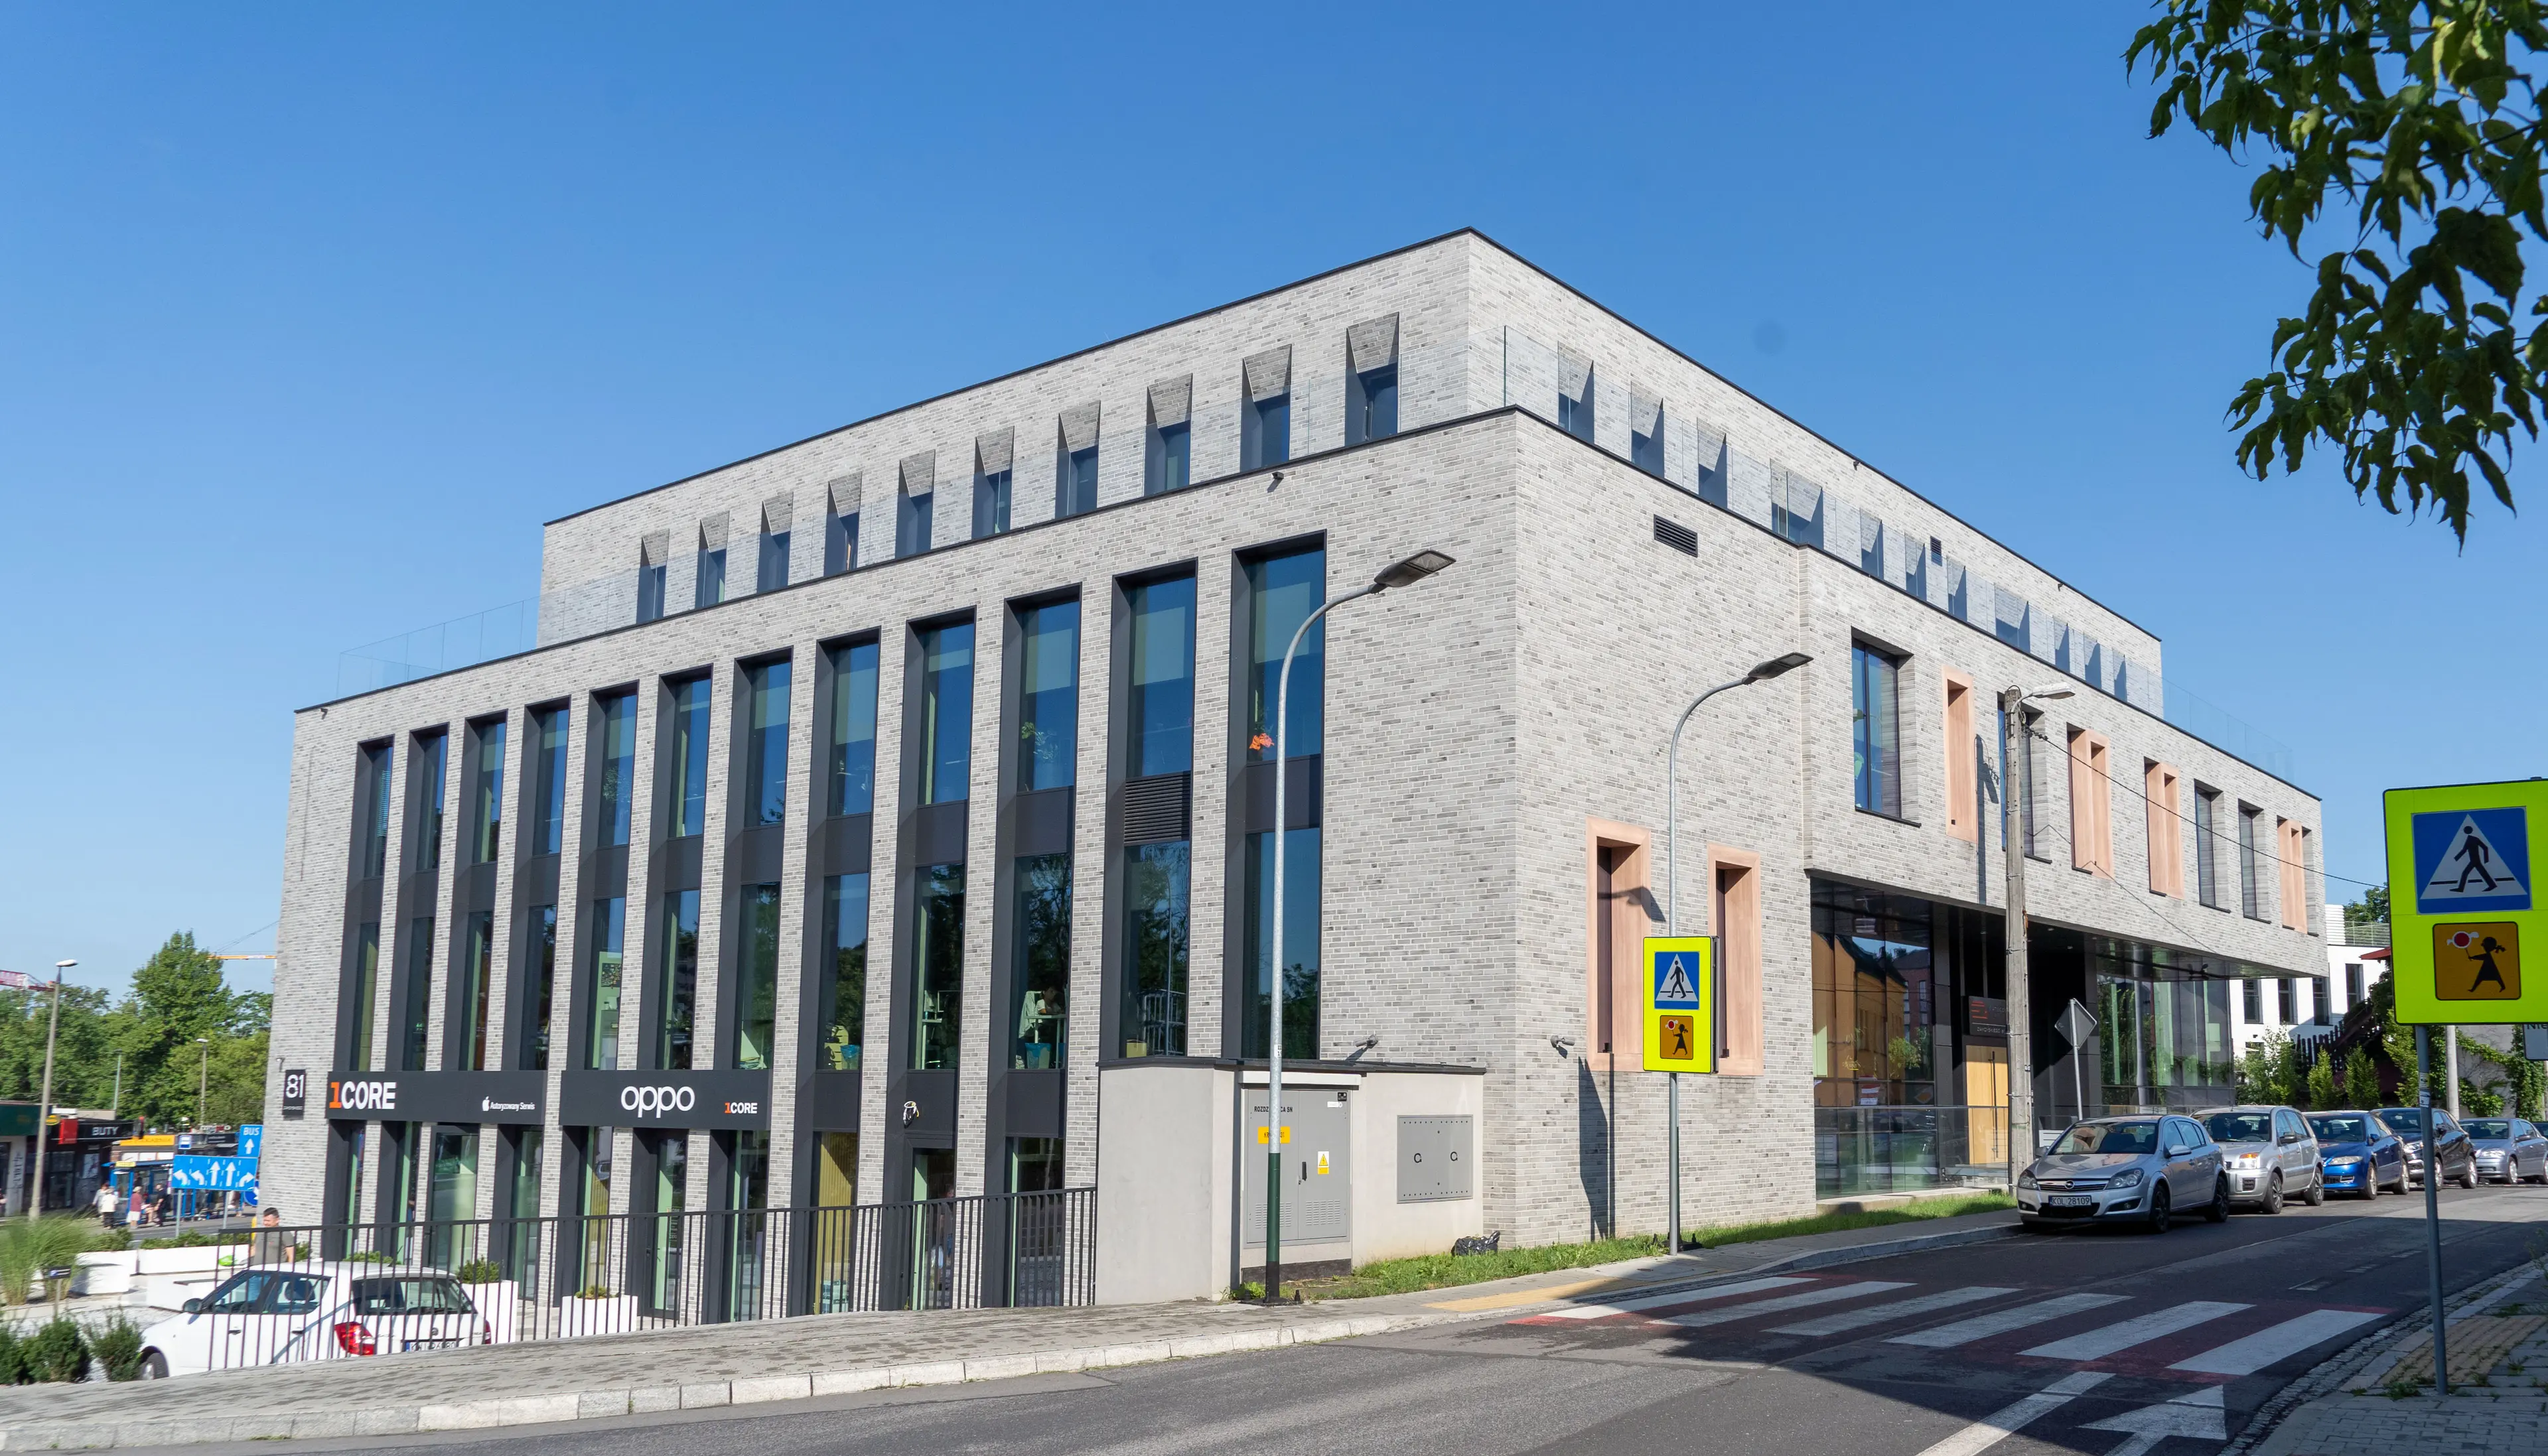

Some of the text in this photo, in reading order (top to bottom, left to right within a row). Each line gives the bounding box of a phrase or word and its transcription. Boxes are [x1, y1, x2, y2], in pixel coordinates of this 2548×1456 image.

[285, 1074, 305, 1098] 81
[329, 1081, 397, 1110] 1CORE
[724, 1102, 758, 1114] 1CORE
[92, 1126, 119, 1136] BUTY
